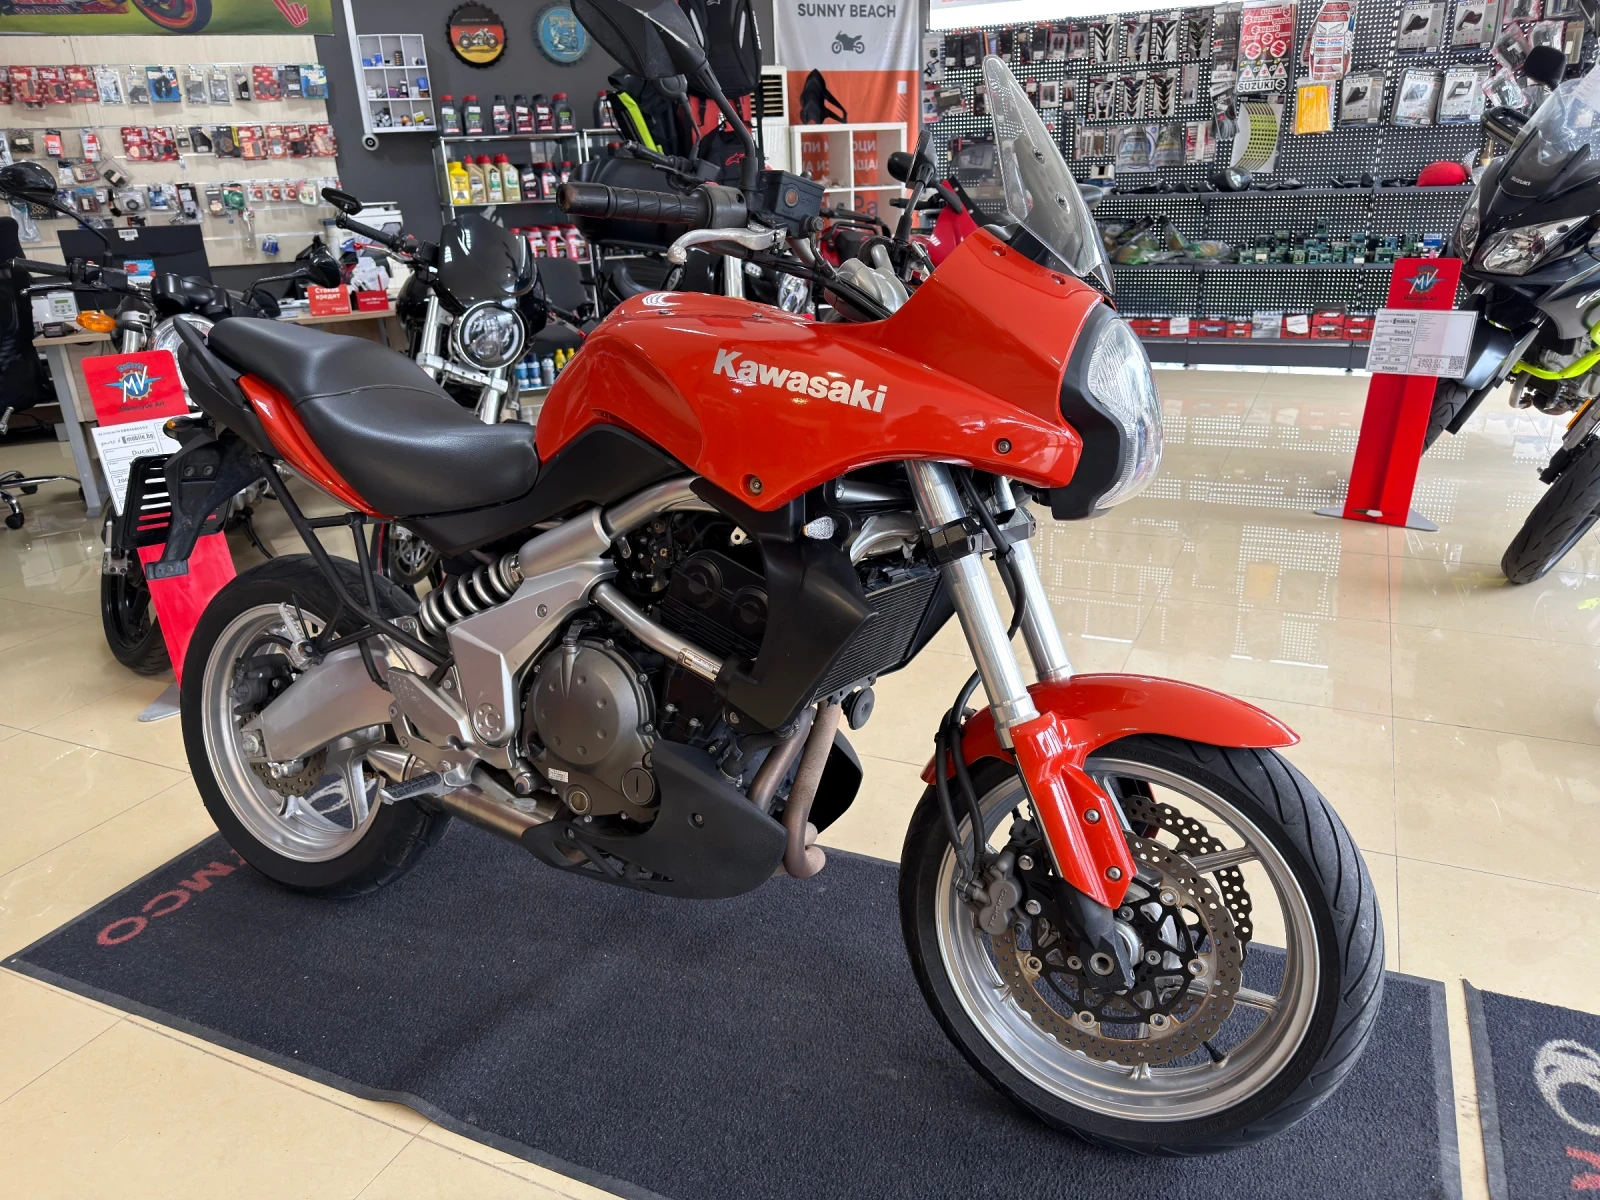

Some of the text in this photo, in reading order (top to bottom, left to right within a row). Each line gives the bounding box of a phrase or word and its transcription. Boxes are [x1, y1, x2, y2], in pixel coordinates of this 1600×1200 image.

[797, 3, 896, 19] SUNNY BEACH
[1238, 82, 1273, 90] SUZUKI
[1510, 175, 1531, 187] SUZUKI
[1409, 269, 1439, 294] MV
[123, 366, 147, 403] MV
[713, 348, 888, 413] Kawasaki
[120, 403, 153, 412] Motorcycle
[126, 433, 154, 442] mobile.bg
[132, 447, 155, 455] Ducati
[988, 888, 1008, 927] TOKICO
